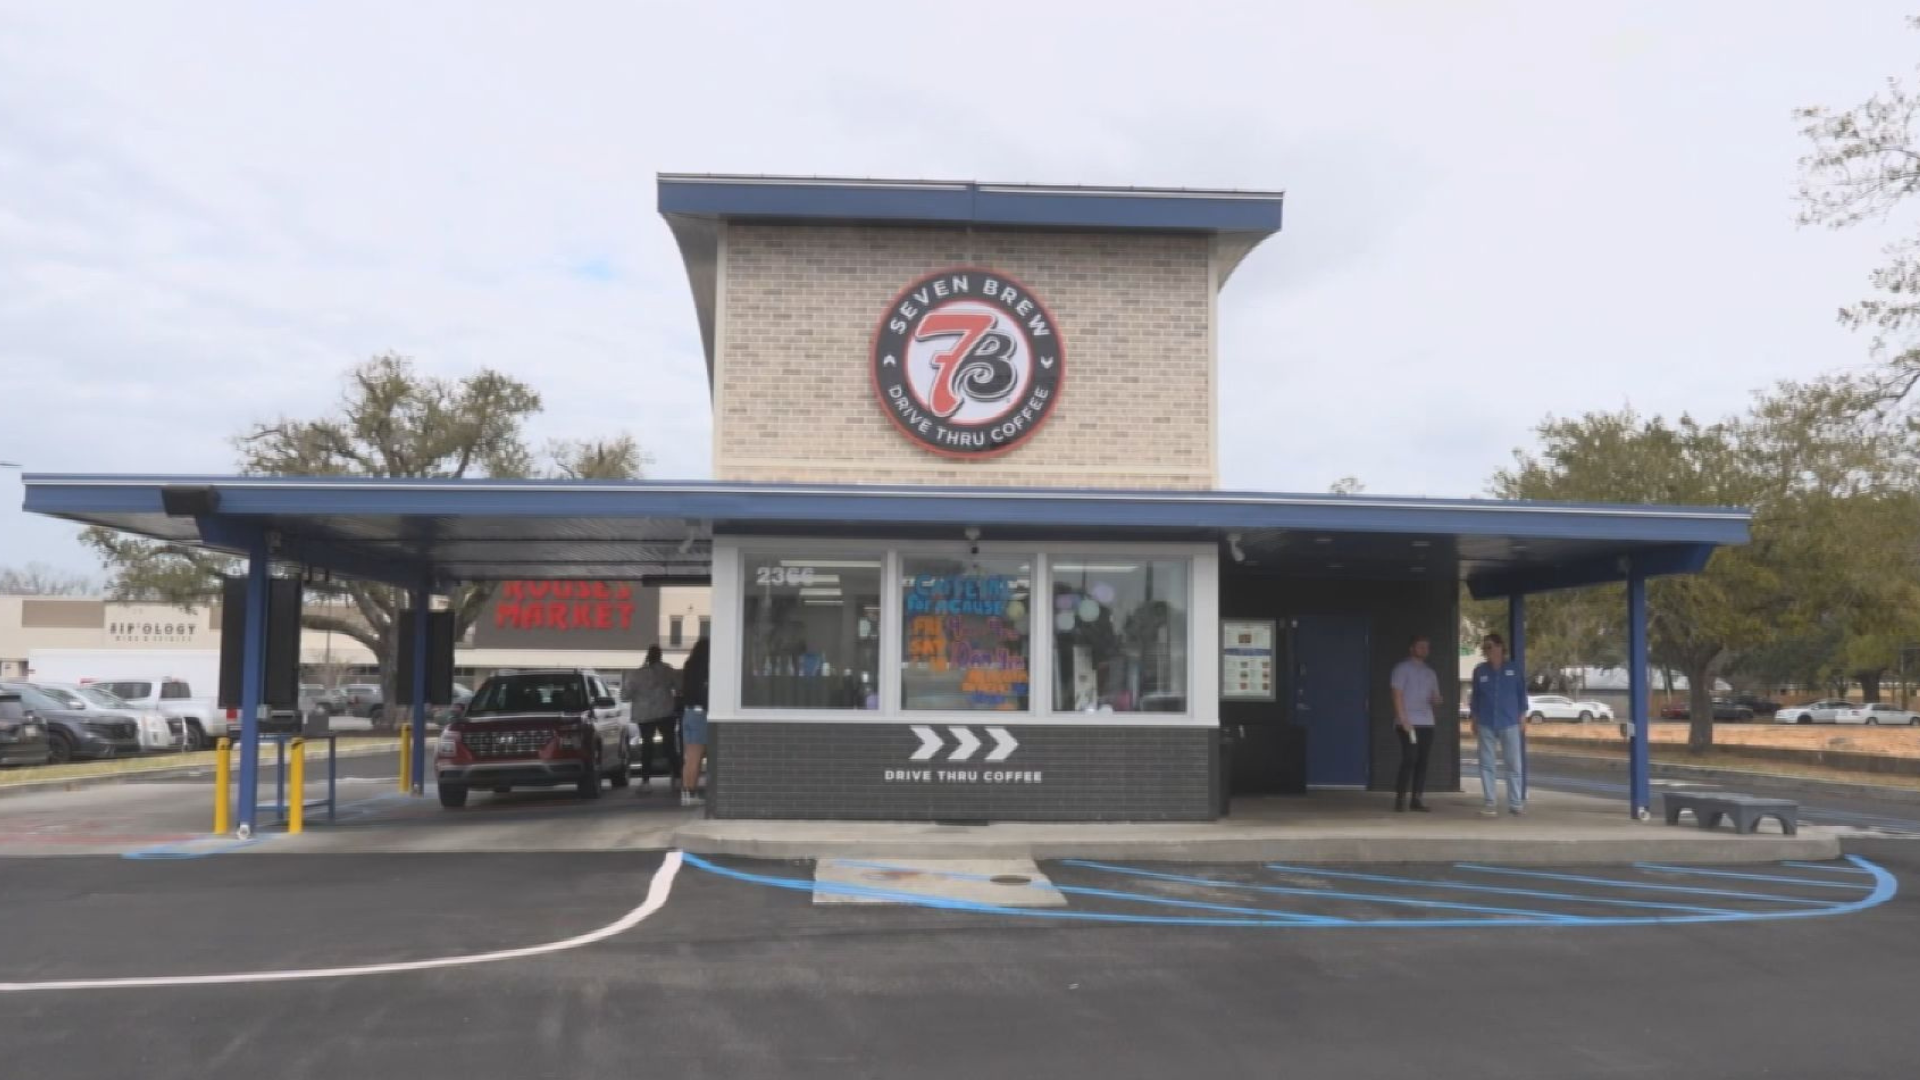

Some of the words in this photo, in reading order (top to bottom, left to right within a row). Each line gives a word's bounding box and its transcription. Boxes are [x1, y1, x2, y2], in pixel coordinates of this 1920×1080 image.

[890, 275, 969, 335] SEVEN
[983, 279, 1050, 336] BREW
[889, 384, 932, 433] DRIVE
[936, 428, 985, 445] THRU
[991, 386, 1048, 442] COFFEE
[757, 566, 814, 586] 2366
[495, 601, 635, 630] MARKET
[884, 769, 932, 781] DRIVE
[937, 769, 977, 781] THRU
[983, 770, 1042, 783] COFFEE
